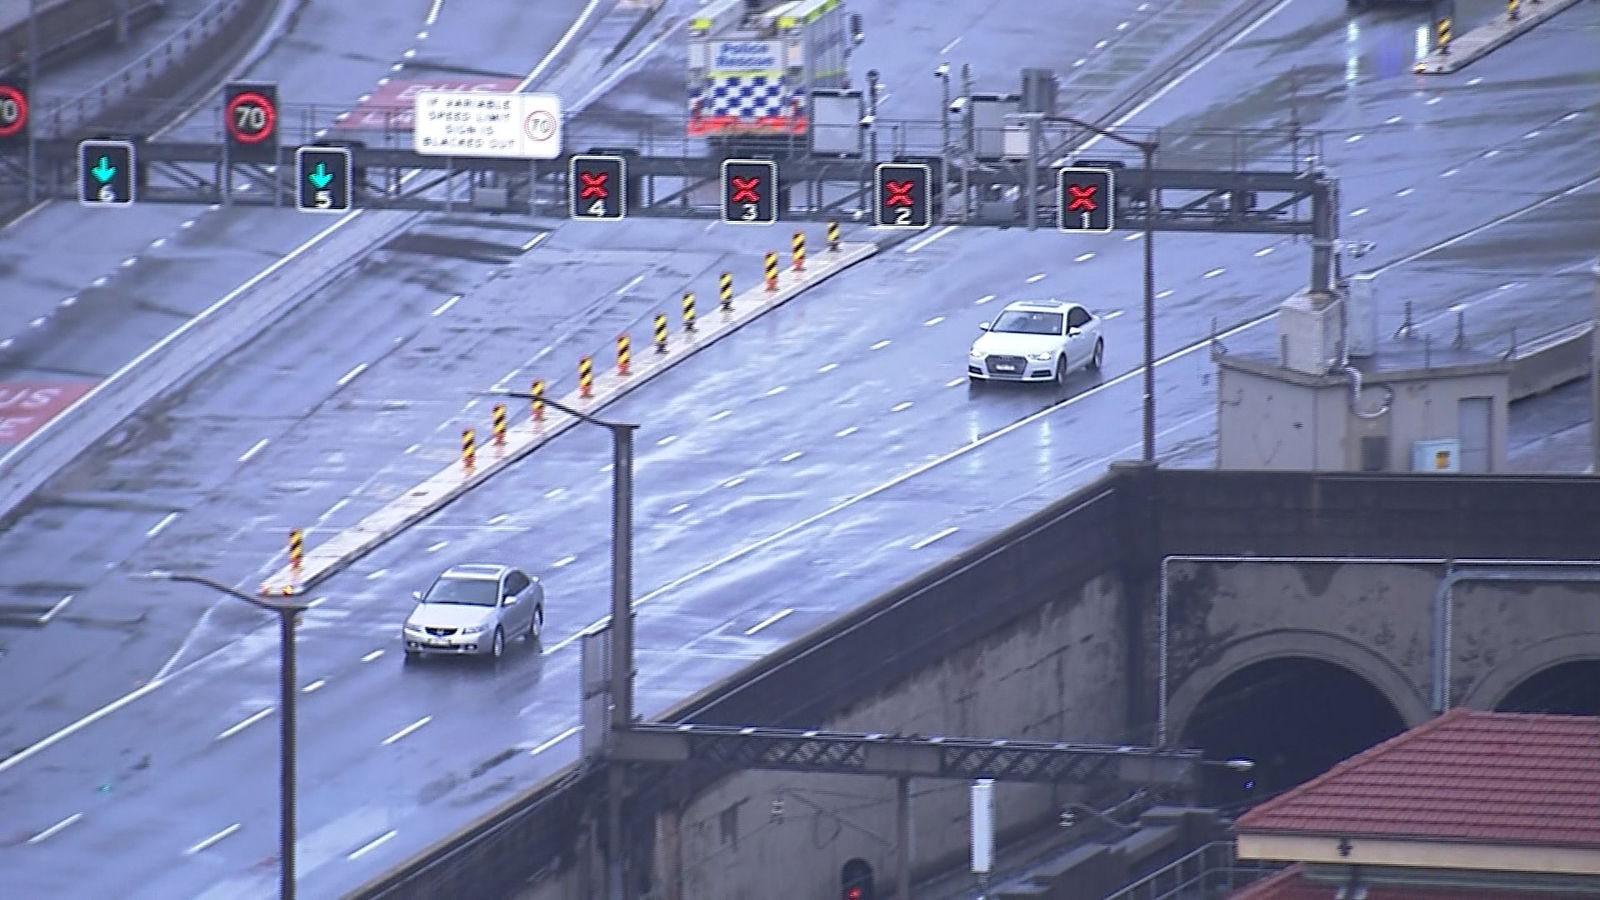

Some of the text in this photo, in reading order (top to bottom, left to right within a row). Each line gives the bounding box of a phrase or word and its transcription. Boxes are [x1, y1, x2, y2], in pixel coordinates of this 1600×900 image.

[0, 99, 17, 122] 0
[235, 107, 266, 129] 70
[99, 186, 116, 202] 6
[315, 191, 333, 209] 5
[587, 200, 606, 217] 4
[742, 205, 757, 221] 3
[895, 207, 912, 225] 2
[1080, 212, 1091, 229] 1
[0, 389, 63, 408] US
